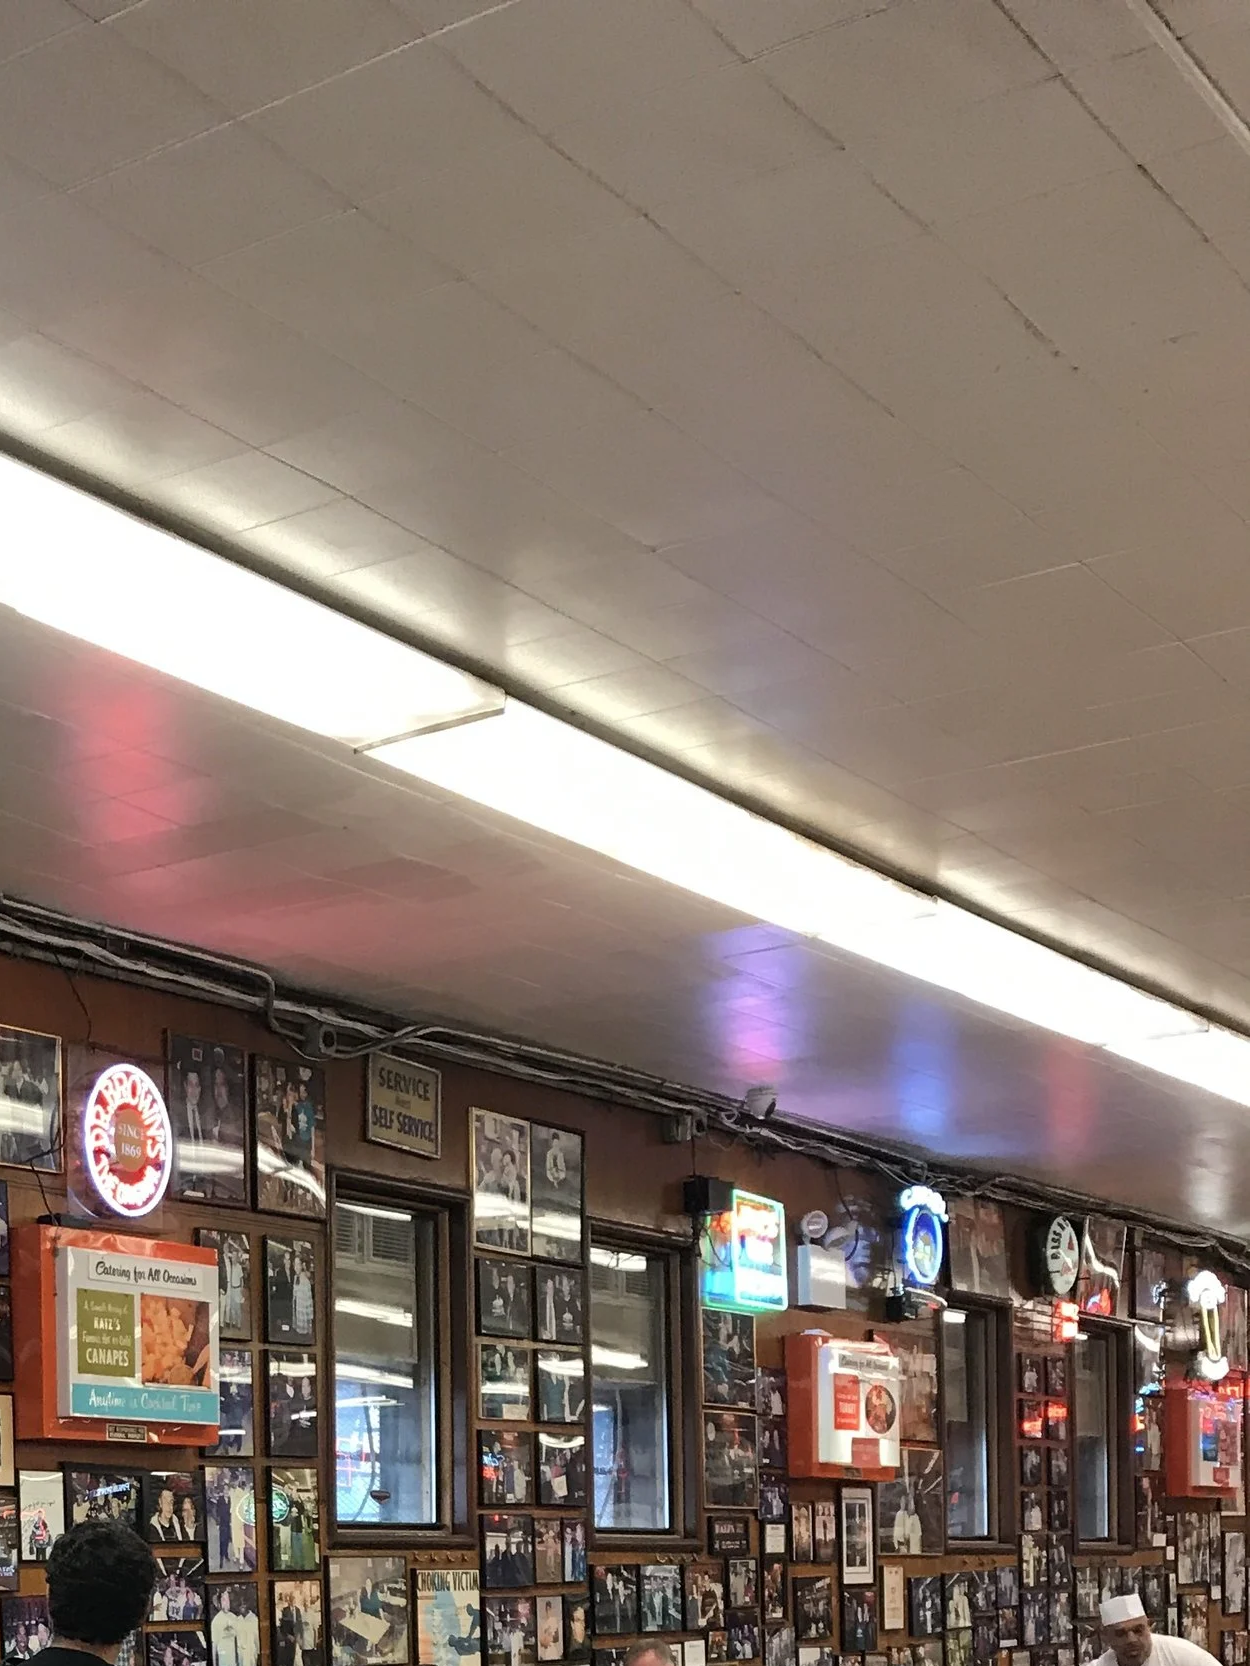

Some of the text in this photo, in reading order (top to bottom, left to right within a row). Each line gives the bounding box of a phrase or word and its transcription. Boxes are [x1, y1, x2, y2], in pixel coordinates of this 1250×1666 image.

[378, 1066, 431, 1102] SERVICE
[371, 1104, 436, 1143] SELF SERVICE
[95, 1260, 198, 1287] Catering for All Occasions
[93, 1316, 122, 1331] KATZ'S
[85, 1348, 130, 1367] CANAPES
[88, 1390, 126, 1413] Anytime
[417, 1571, 451, 1592] CHOKING
